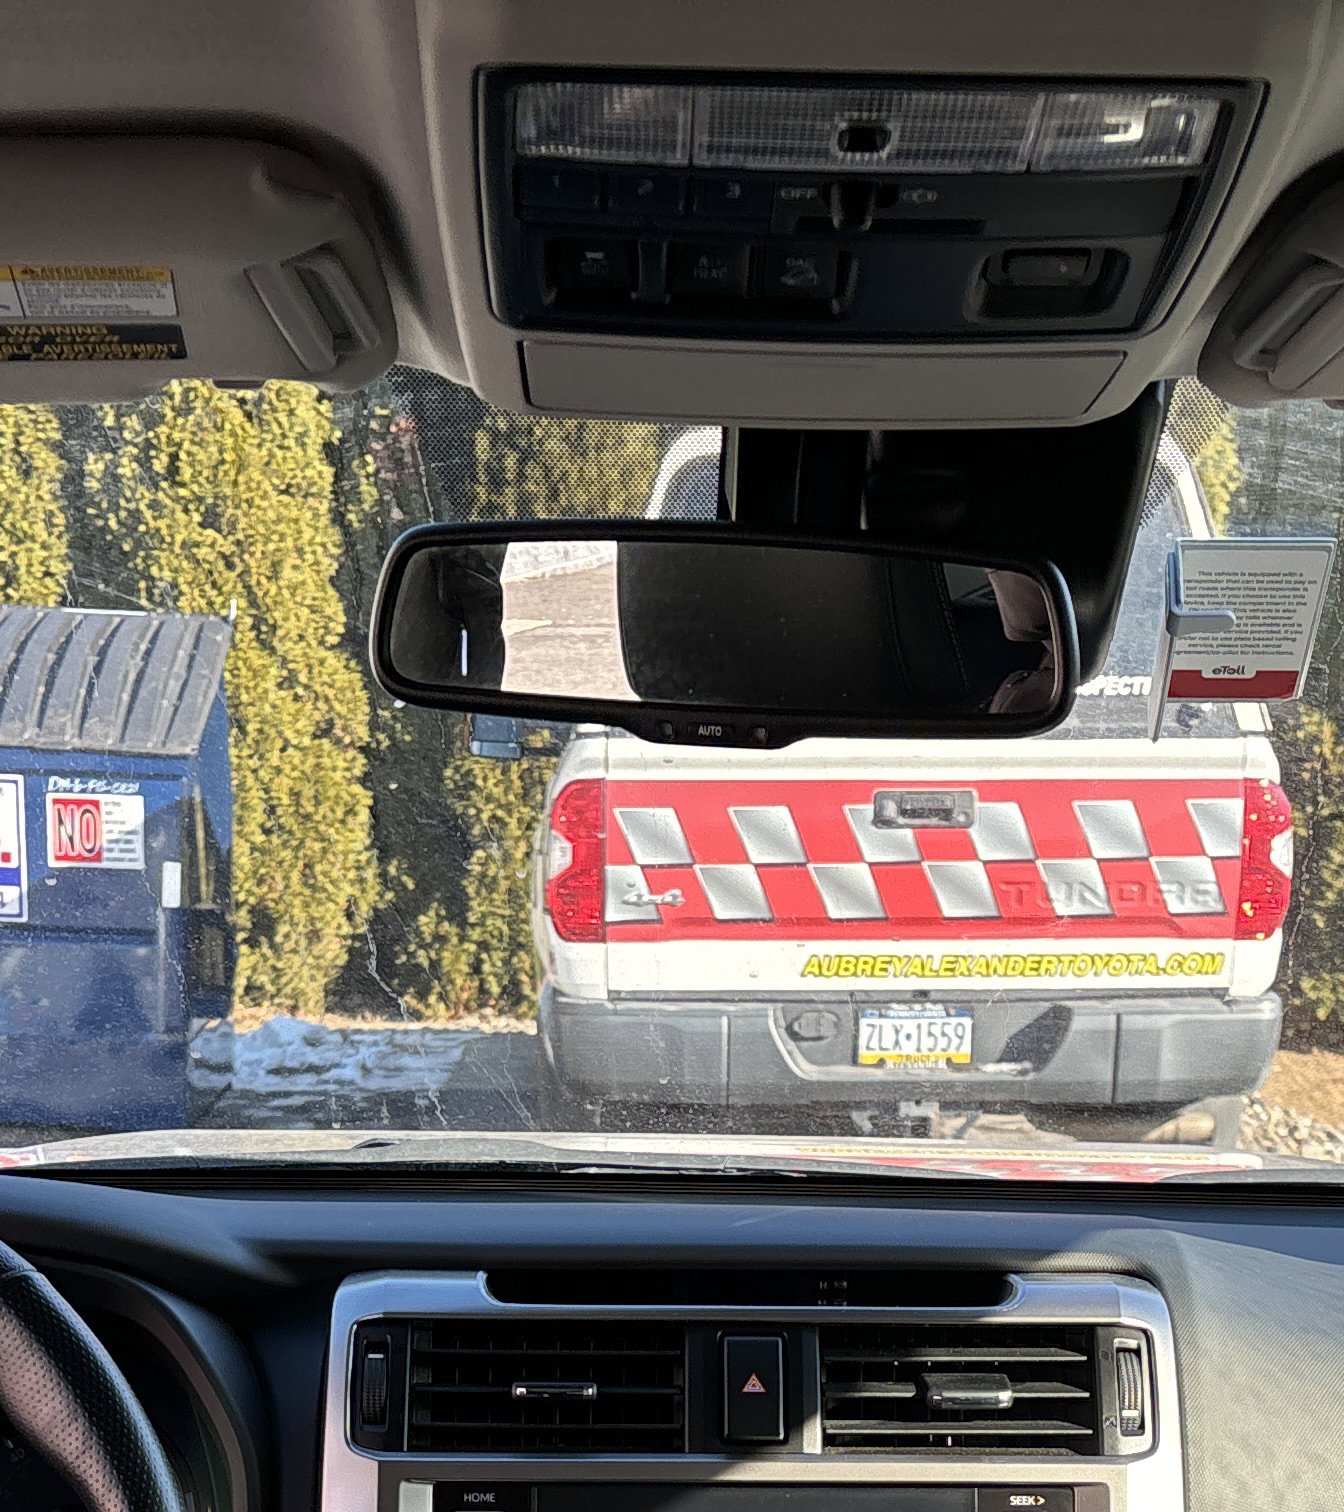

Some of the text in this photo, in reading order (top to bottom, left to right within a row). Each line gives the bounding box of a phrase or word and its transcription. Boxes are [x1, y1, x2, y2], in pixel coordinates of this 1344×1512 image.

[8, 326, 107, 336] WARNING
[42, 343, 178, 355] AVERTISSEMENT
[1212, 665, 1245, 676] eToll
[698, 724, 722, 737] AUTO
[53, 803, 102, 857] NO
[999, 880, 1221, 911] TUNDRA
[801, 953, 1225, 978] AUBREYALEXANDERTOYOTA.COM
[464, 1493, 496, 1502] HOME
